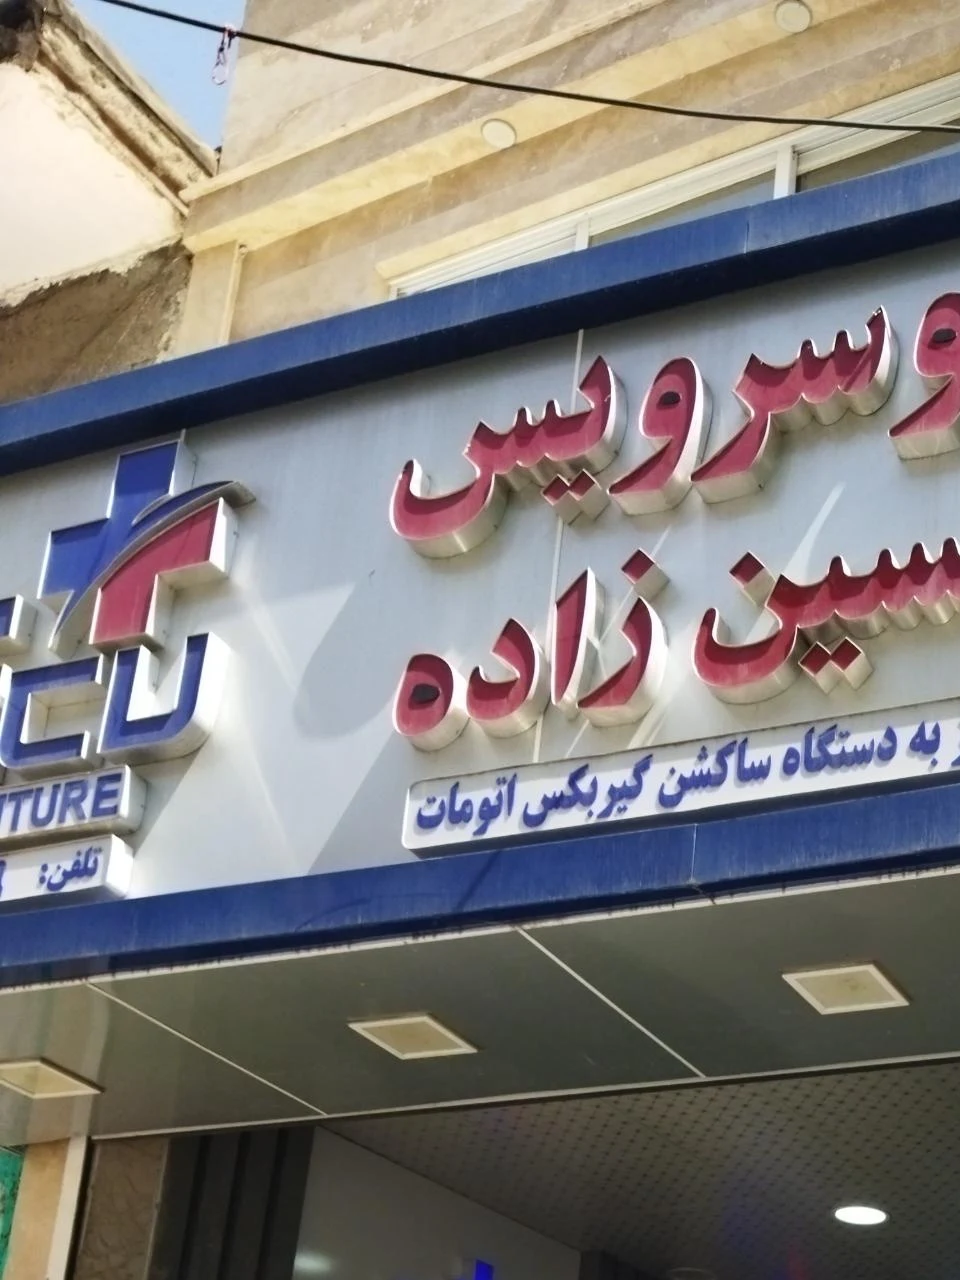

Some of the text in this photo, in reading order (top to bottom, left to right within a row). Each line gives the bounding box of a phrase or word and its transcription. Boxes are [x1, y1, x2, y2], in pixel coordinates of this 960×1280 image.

[393, 548, 668, 750] زاده
[658, 737, 772, 808] ساکشن
[782, 723, 899, 776] دستگاه
[909, 719, 942, 767] به
[415, 772, 519, 837] اتومات
[522, 754, 654, 829] گیربکس
[39, 847, 103, 892] تلفن:
